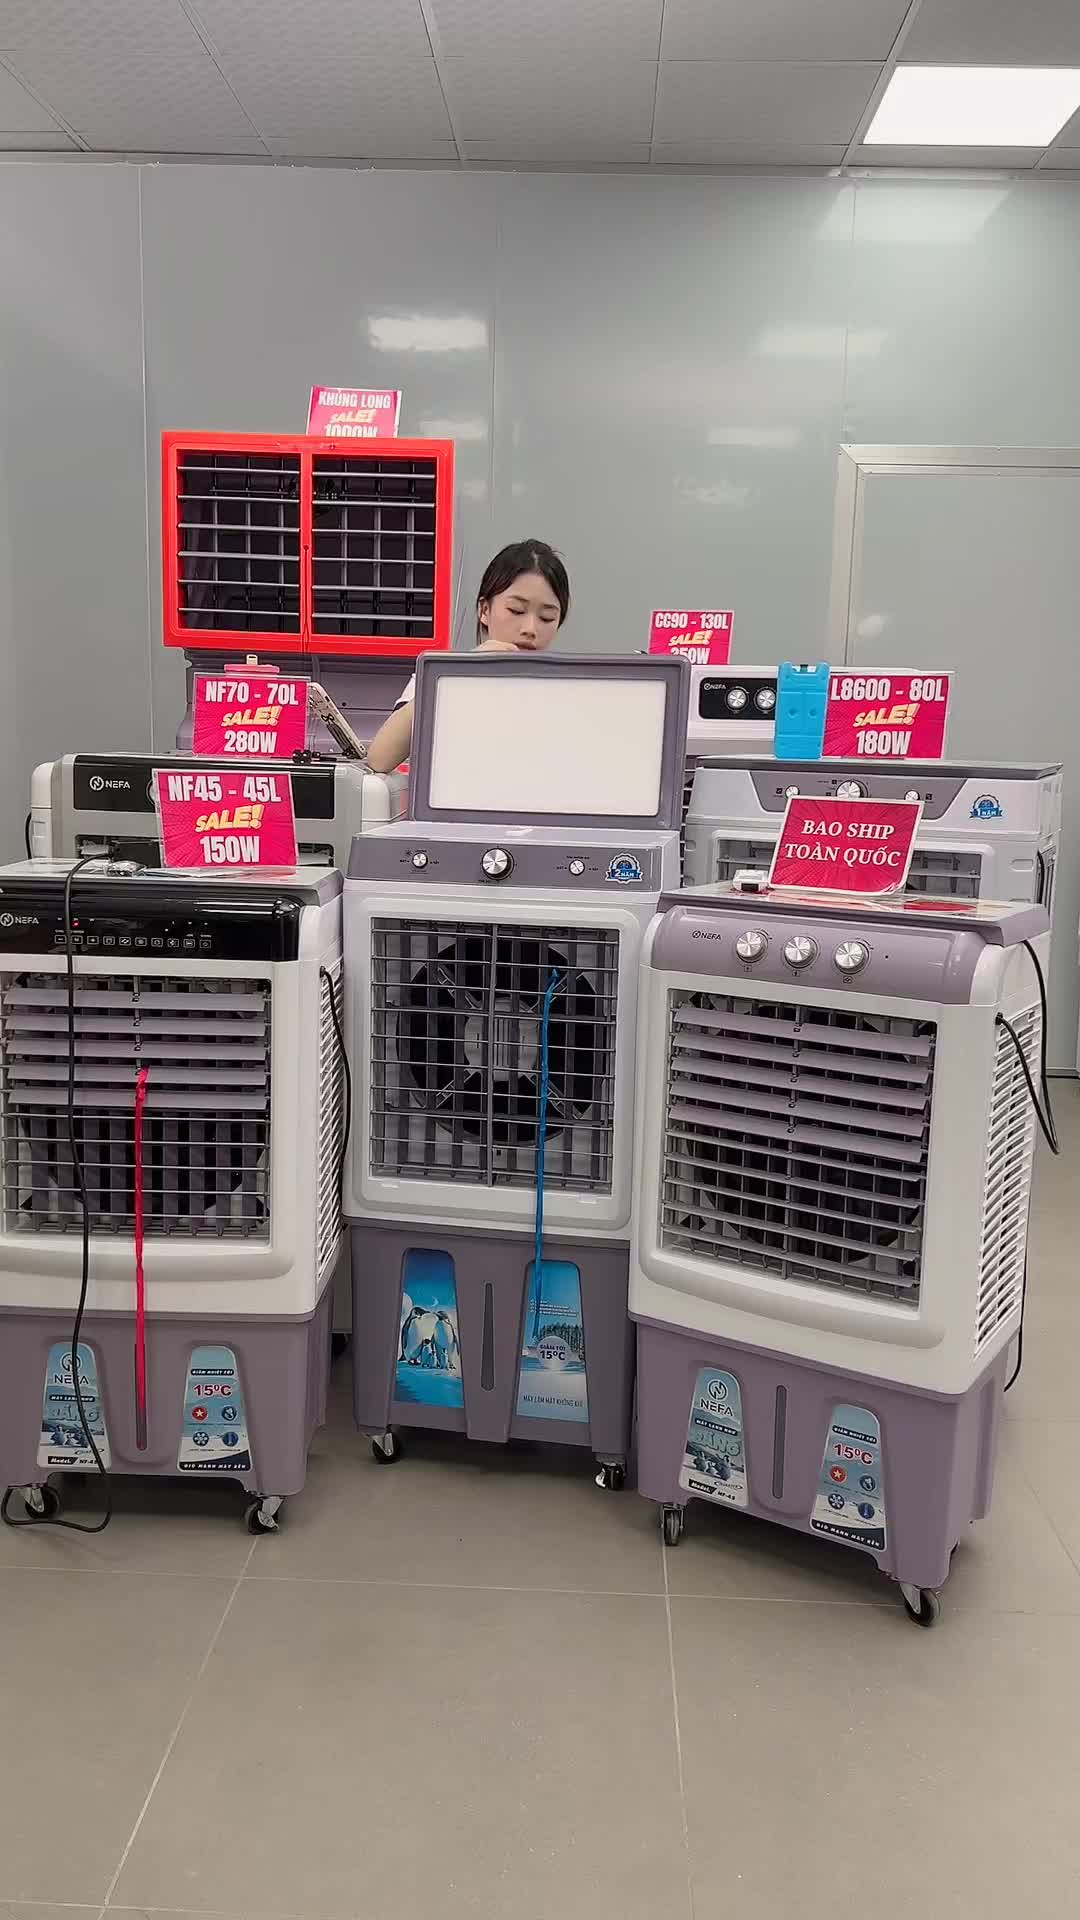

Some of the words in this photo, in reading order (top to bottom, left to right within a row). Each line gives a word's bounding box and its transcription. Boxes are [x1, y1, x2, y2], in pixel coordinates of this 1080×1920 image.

[361, 394, 392, 409] LONG
[329, 409, 376, 424] SALE!
[700, 614, 728, 629] 130L
[668, 630, 713, 646] SALE!
[205, 681, 249, 703] NF70
[267, 683, 299, 705] 70L
[830, 678, 891, 701] L8600
[909, 678, 945, 701] 80L
[221, 706, 283, 727] SALE!
[852, 703, 920, 727] SALE!
[224, 730, 277, 753] 280W
[856, 730, 912, 755] 180W
[105, 780, 131, 789] NEFA
[167, 776, 222, 802] NF45
[243, 776, 281, 802] 45L
[195, 804, 265, 833] SALE!
[801, 820, 843, 837] BAO
[847, 823, 895, 840] SHIP
[200, 836, 260, 863] 150W
[785, 842, 840, 862] TOÀN
[843, 846, 901, 868] QUỐC
[15, 917, 40, 925] NEFA
[701, 932, 722, 941] NEFA
[54, 1374, 89, 1385] NEA
[700, 1399, 733, 1417] NEFA
